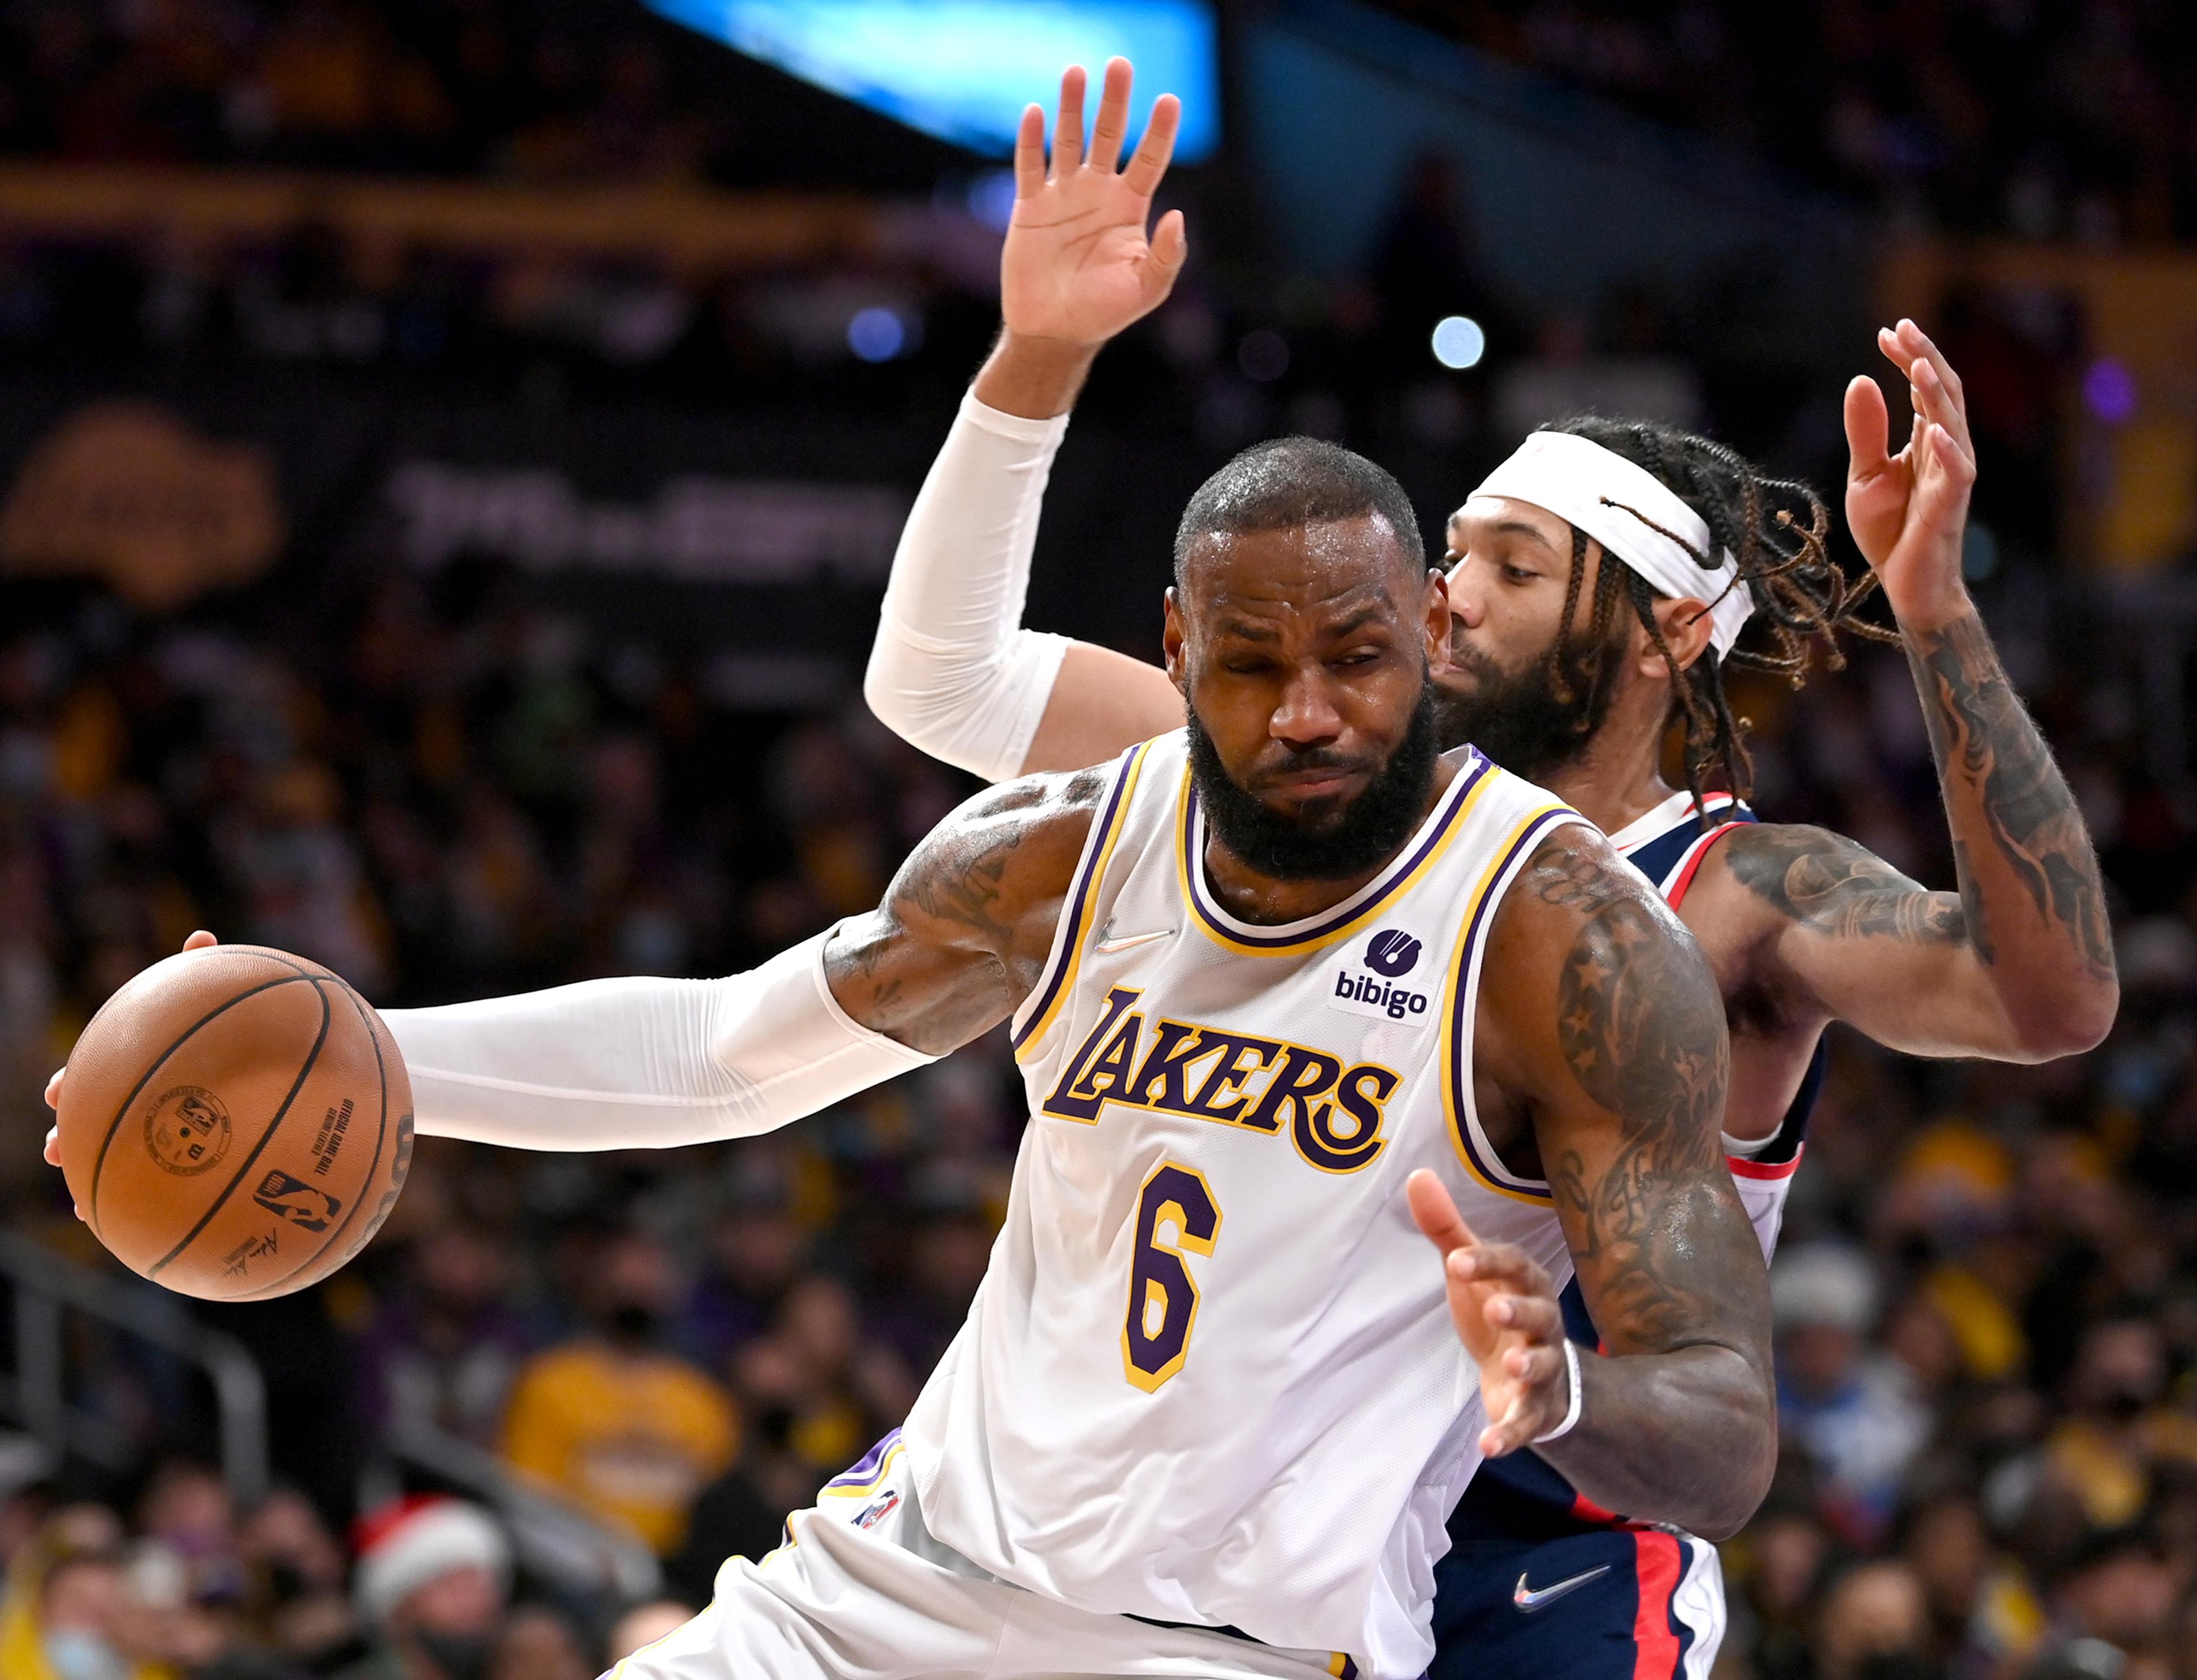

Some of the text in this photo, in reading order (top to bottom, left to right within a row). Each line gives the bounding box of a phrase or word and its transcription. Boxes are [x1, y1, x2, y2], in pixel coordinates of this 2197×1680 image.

[1335, 970, 1427, 1019] bibigo
[1041, 984, 1404, 1175] LAKERS
[334, 1098, 354, 1134] OFFICIAL
[264, 1173, 286, 1196] NBA
[314, 1155, 333, 1176] BALL
[1120, 1159, 1224, 1394] 6
